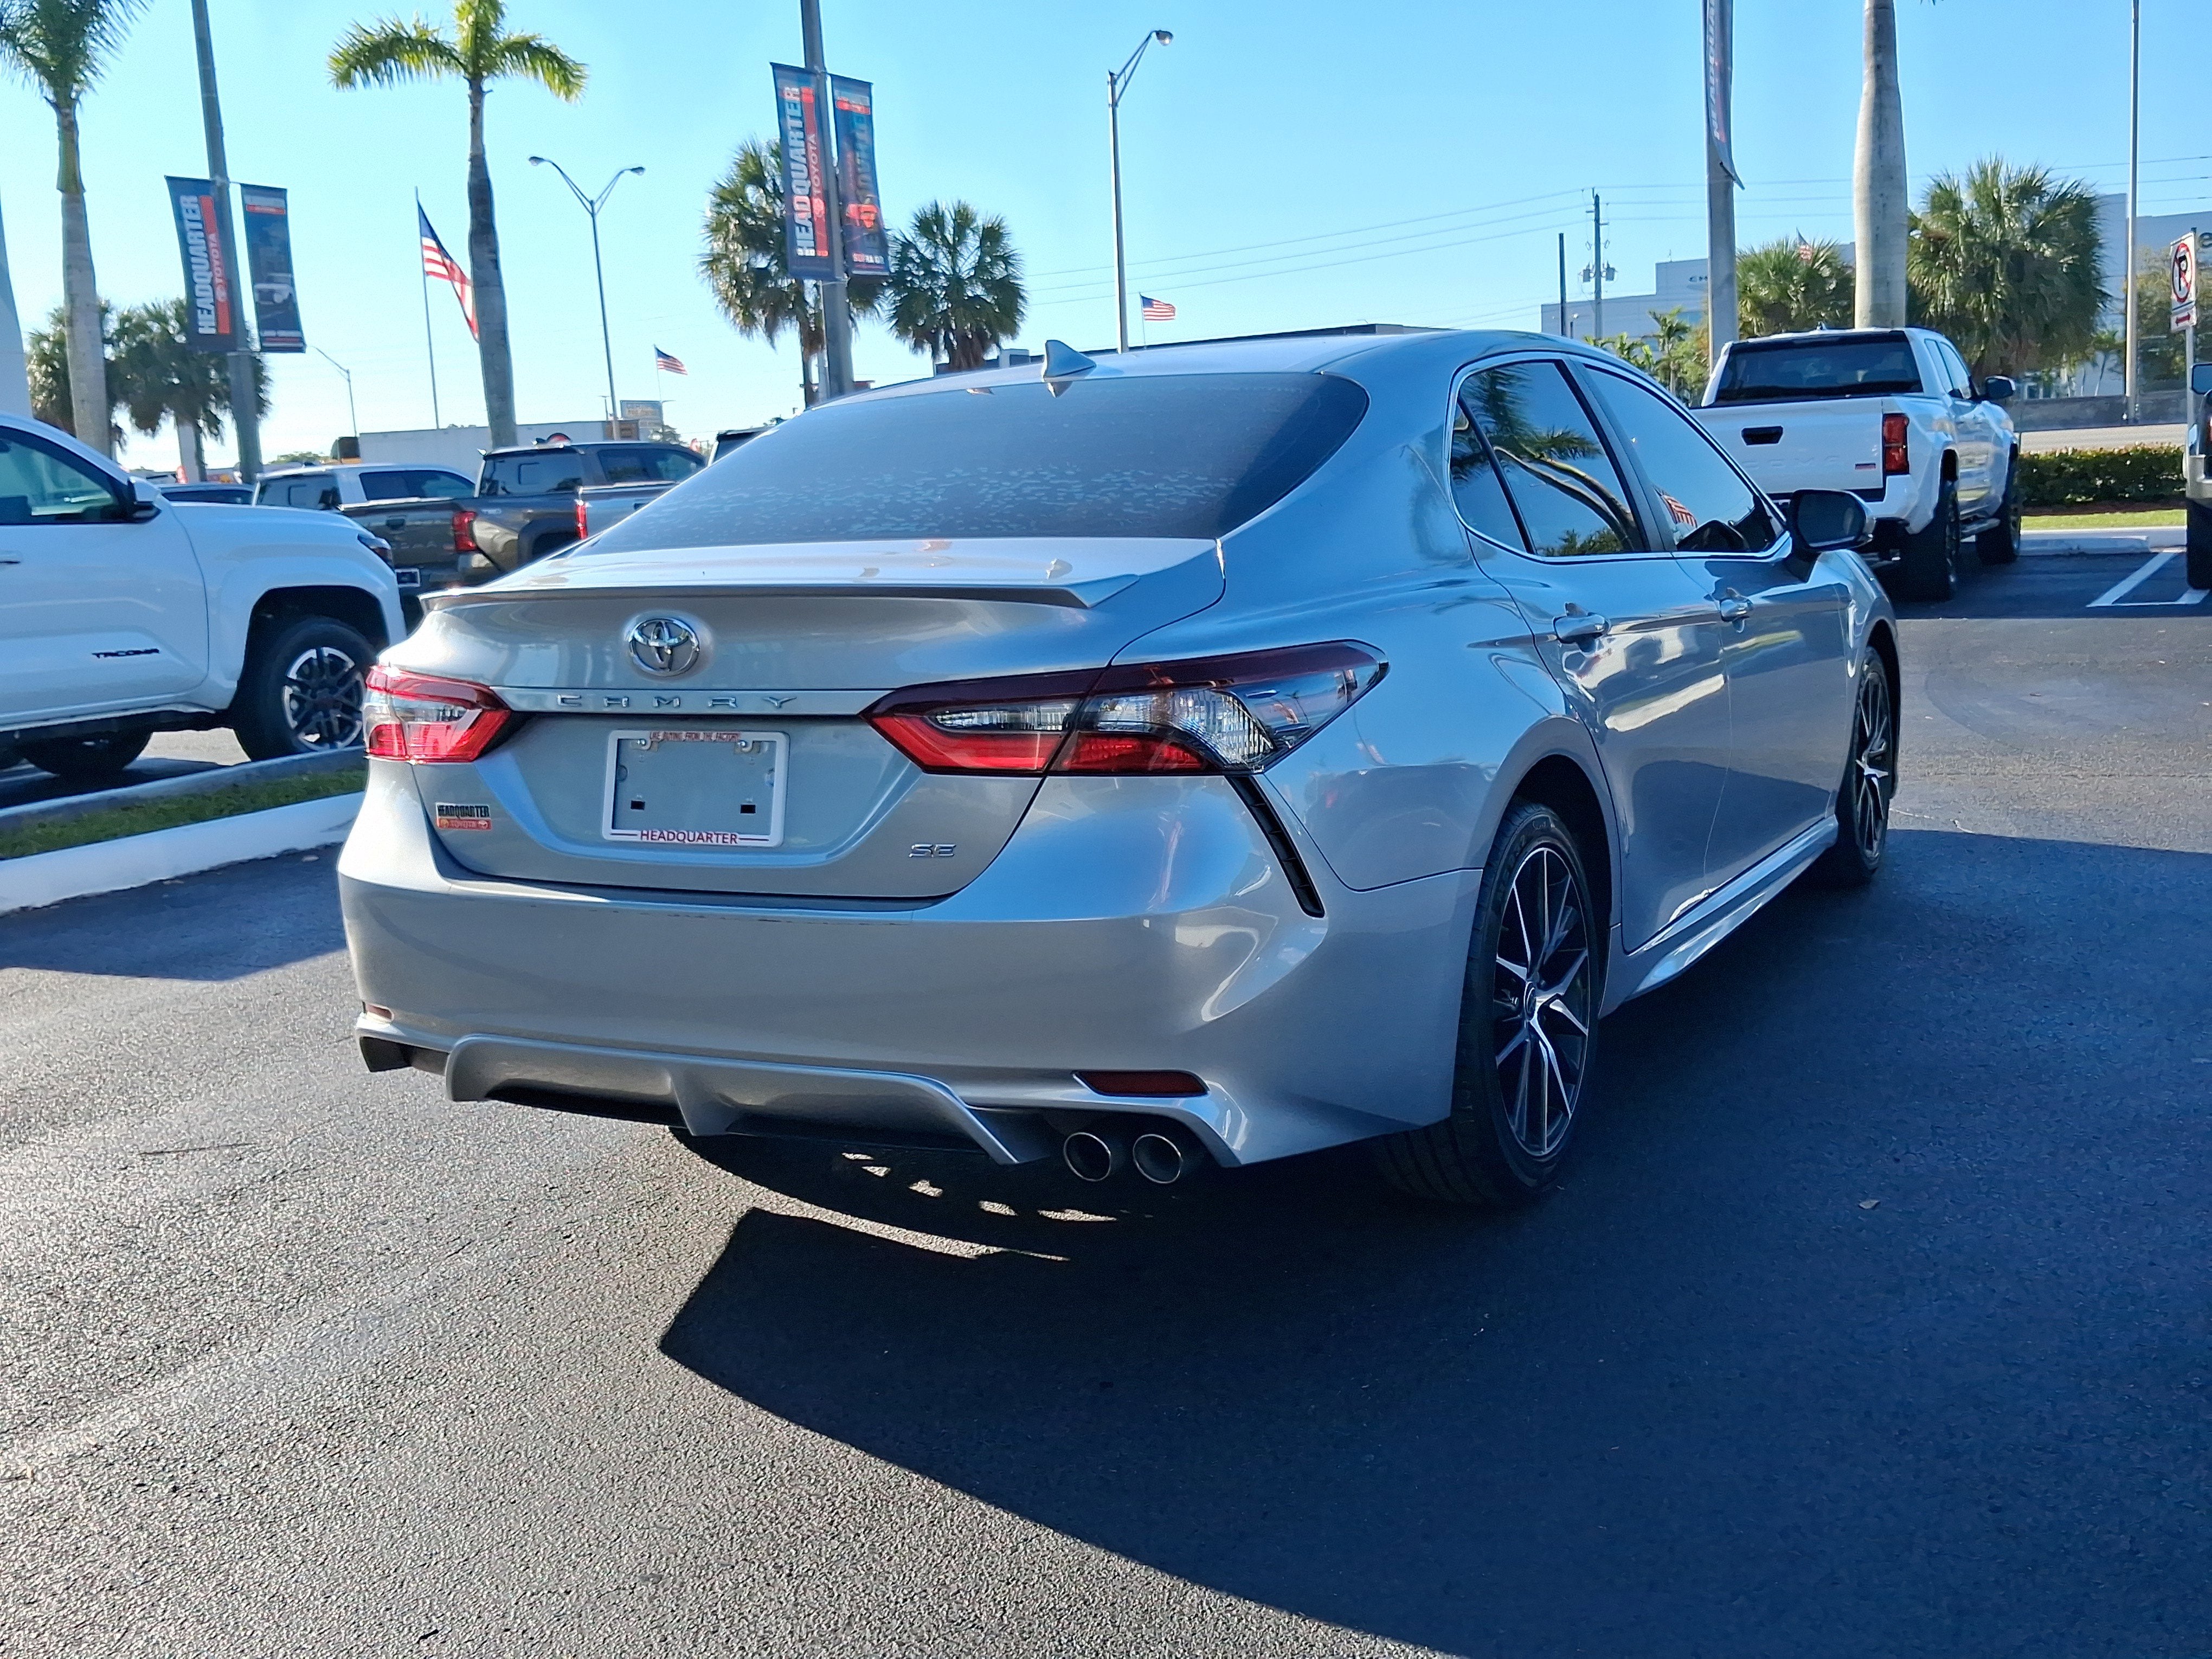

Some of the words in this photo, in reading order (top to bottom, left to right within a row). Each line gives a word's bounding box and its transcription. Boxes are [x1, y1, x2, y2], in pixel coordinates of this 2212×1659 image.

[784, 87, 815, 256] HEADQUARTER
[808, 133, 820, 196] TOYOTA
[180, 195, 216, 335] HEADQUARTER
[92, 648, 159, 659] TACOMA
[557, 694, 797, 708] CAMRY
[640, 830, 738, 844] HEADQUARTER
[909, 844, 956, 857] SE
